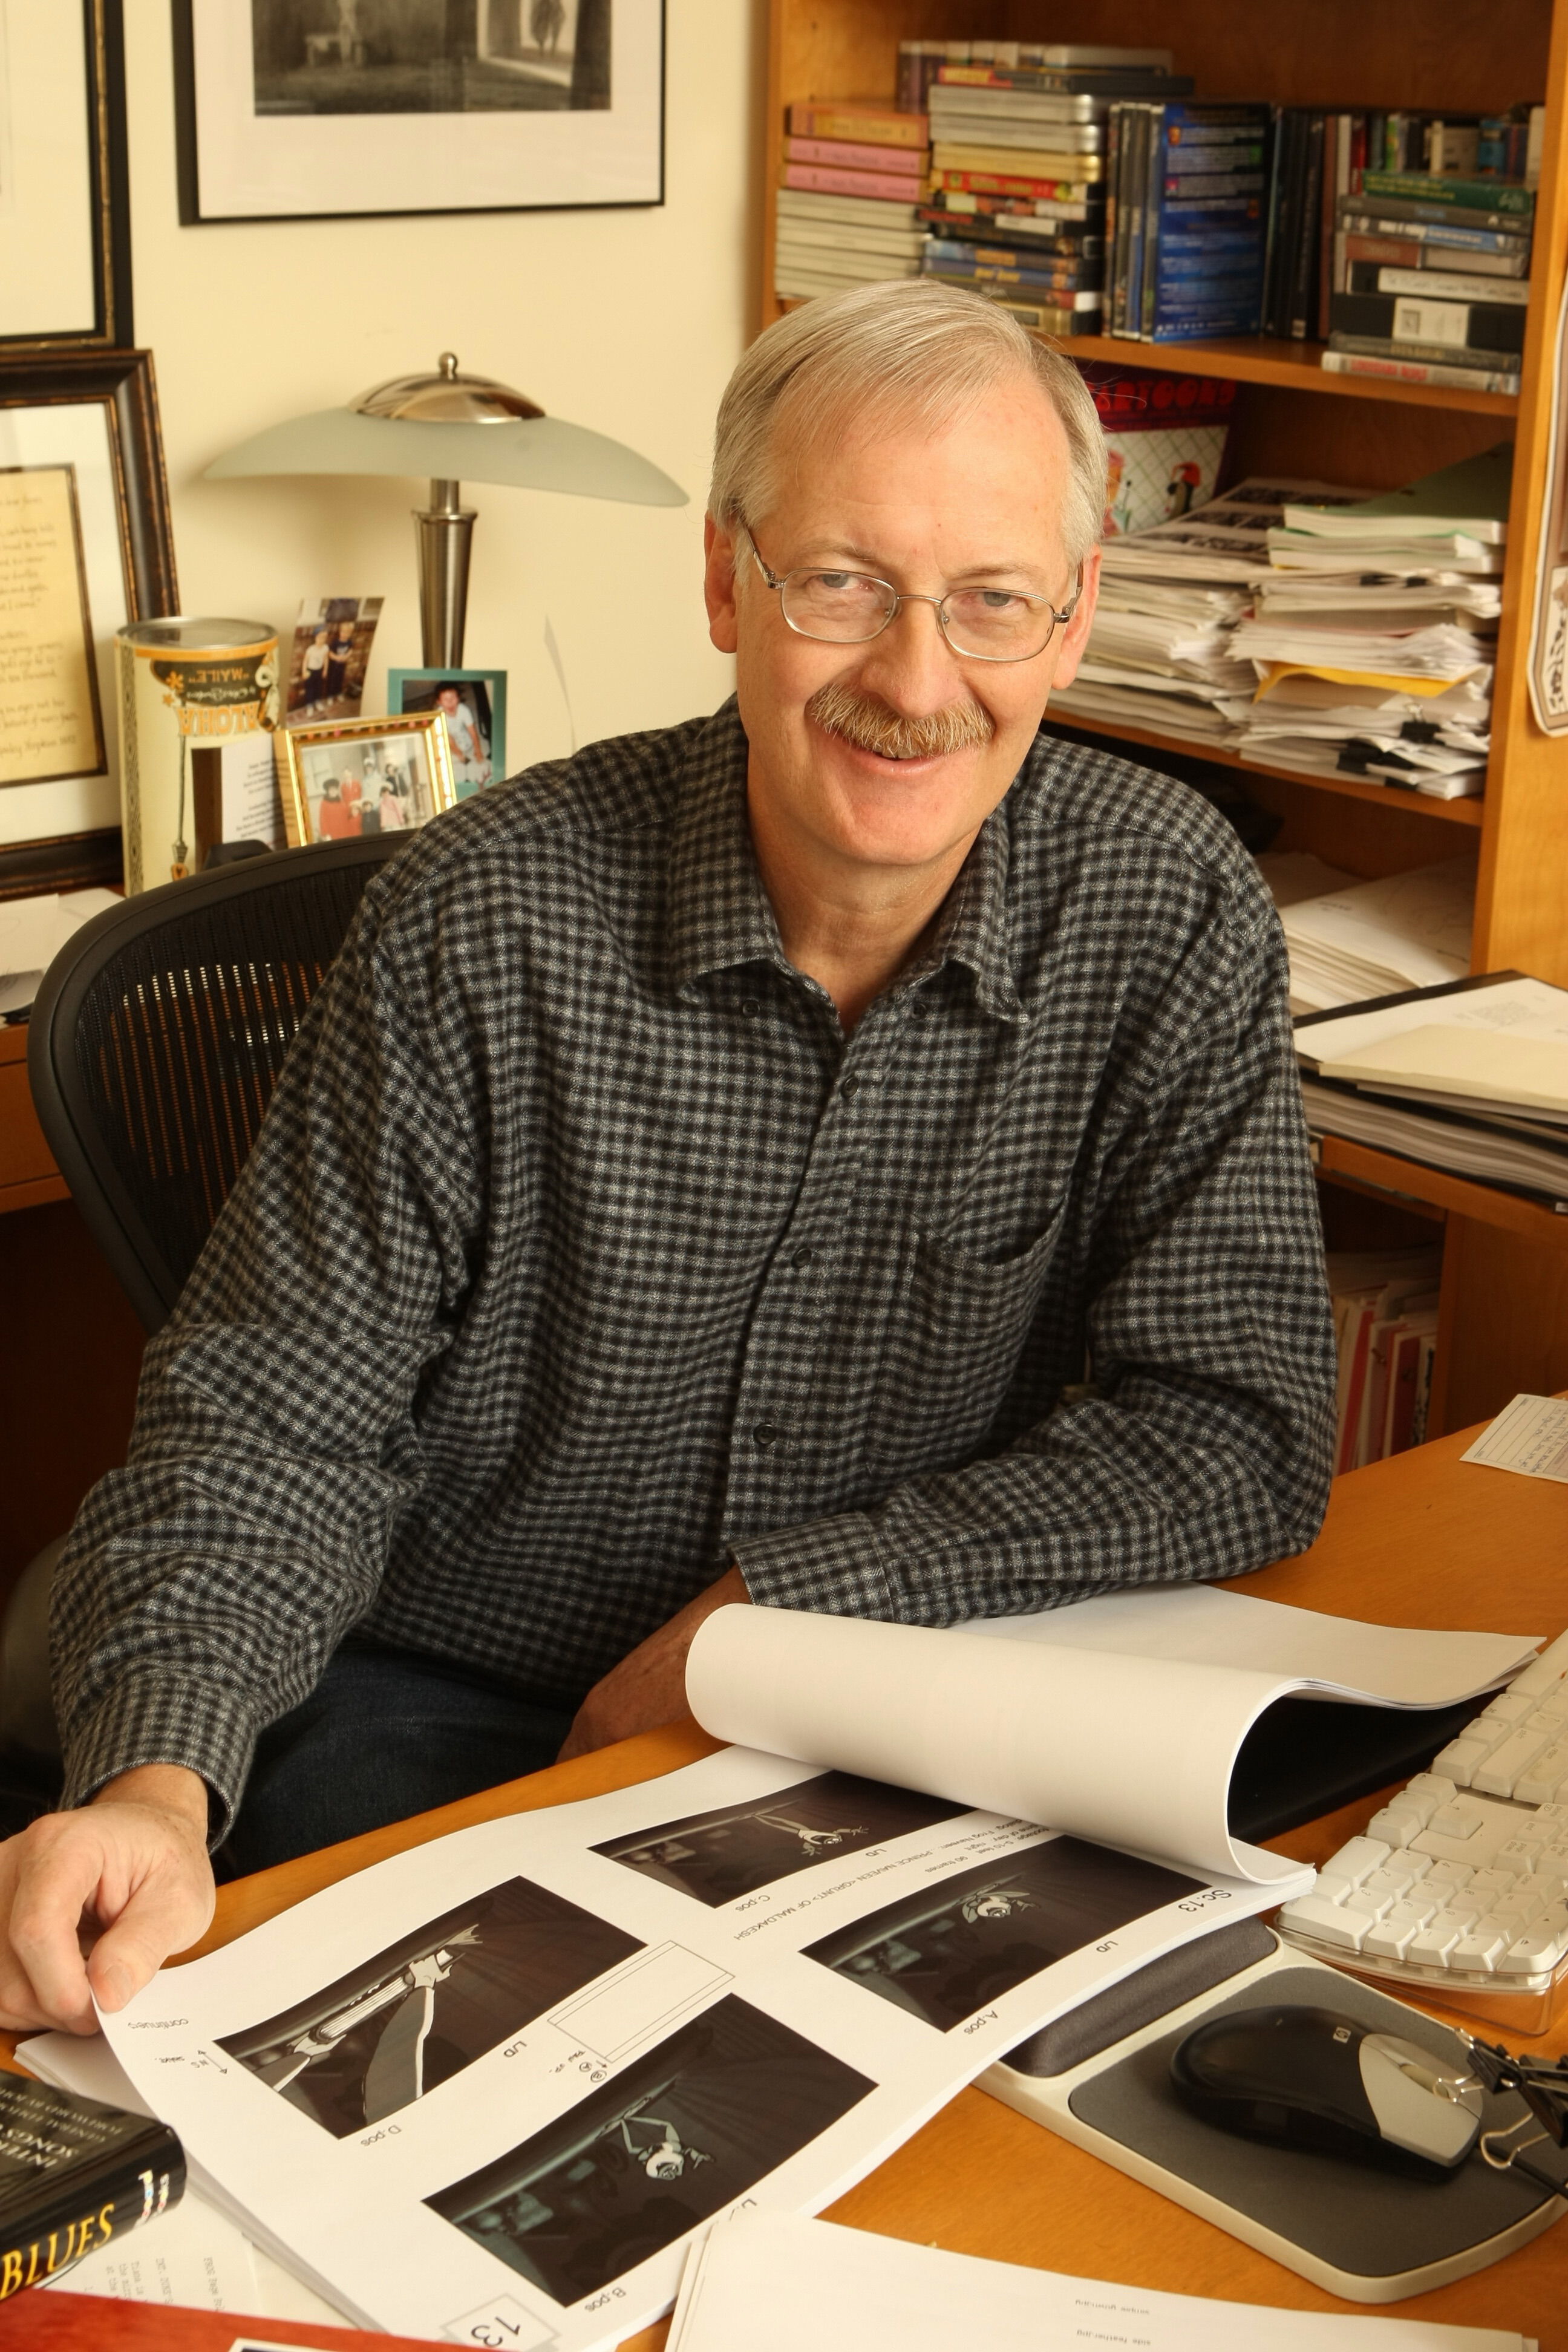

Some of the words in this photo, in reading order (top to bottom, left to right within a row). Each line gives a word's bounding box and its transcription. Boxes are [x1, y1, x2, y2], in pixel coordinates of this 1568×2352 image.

[1087, 379, 1236, 411] ARTOONS
[177, 701, 260, 736] ALOHA
[857, 1863, 897, 1880] NAVEEN
[925, 1860, 956, 1873] frames
[735, 1895, 770, 1912] C.pos
[797, 1900, 811, 1909] OF
[1178, 1889, 1232, 1913] Sc.13
[734, 1907, 797, 1941] MALDAKESH
[128, 2018, 189, 2029] continues
[964, 2010, 998, 2035] A.pos
[2, 2128, 79, 2158] SONGS
[361, 2125, 402, 2147] D.pos
[0, 2203, 114, 2299] BLUES
[584, 2287, 627, 2313] B.pos
[471, 2316, 520, 2348] 13
